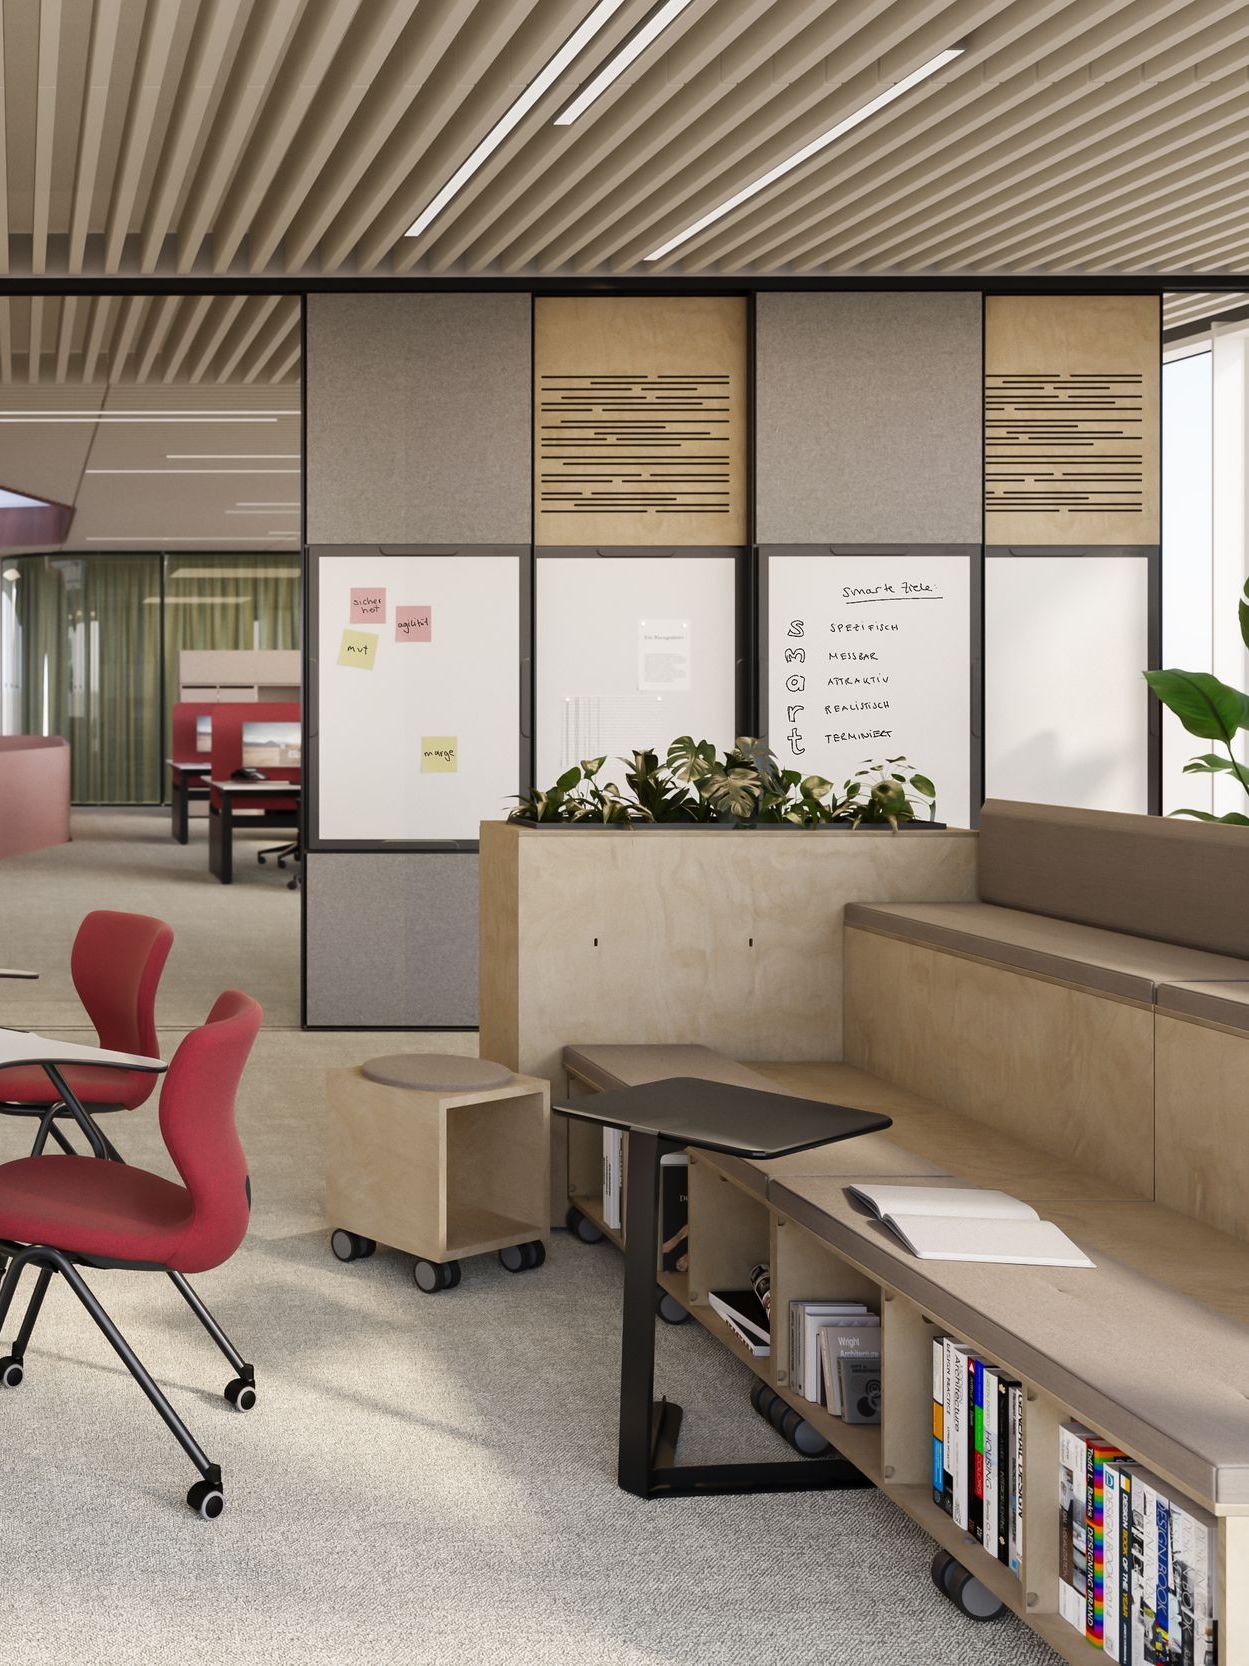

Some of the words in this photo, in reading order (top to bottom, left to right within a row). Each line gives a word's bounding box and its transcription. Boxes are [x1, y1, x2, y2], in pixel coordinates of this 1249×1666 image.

[842, 583, 896, 598] Smarte
[830, 621, 899, 633] SPEZIFISCH
[828, 651, 878, 661] MESSBAR
[827, 672, 890, 686] ATTRAKTIV
[824, 700, 890, 715] REALISTISCH
[824, 729, 893, 744] TERMINIERT
[837, 1336, 860, 1348] Wright
[1087, 1472, 1094, 1482] L.
[1157, 1501, 1168, 1560] DESIGN
[1122, 1557, 1129, 1571] OF
[1157, 1563, 1168, 1615] BOOK
[1182, 1582, 1193, 1636] BOOK
